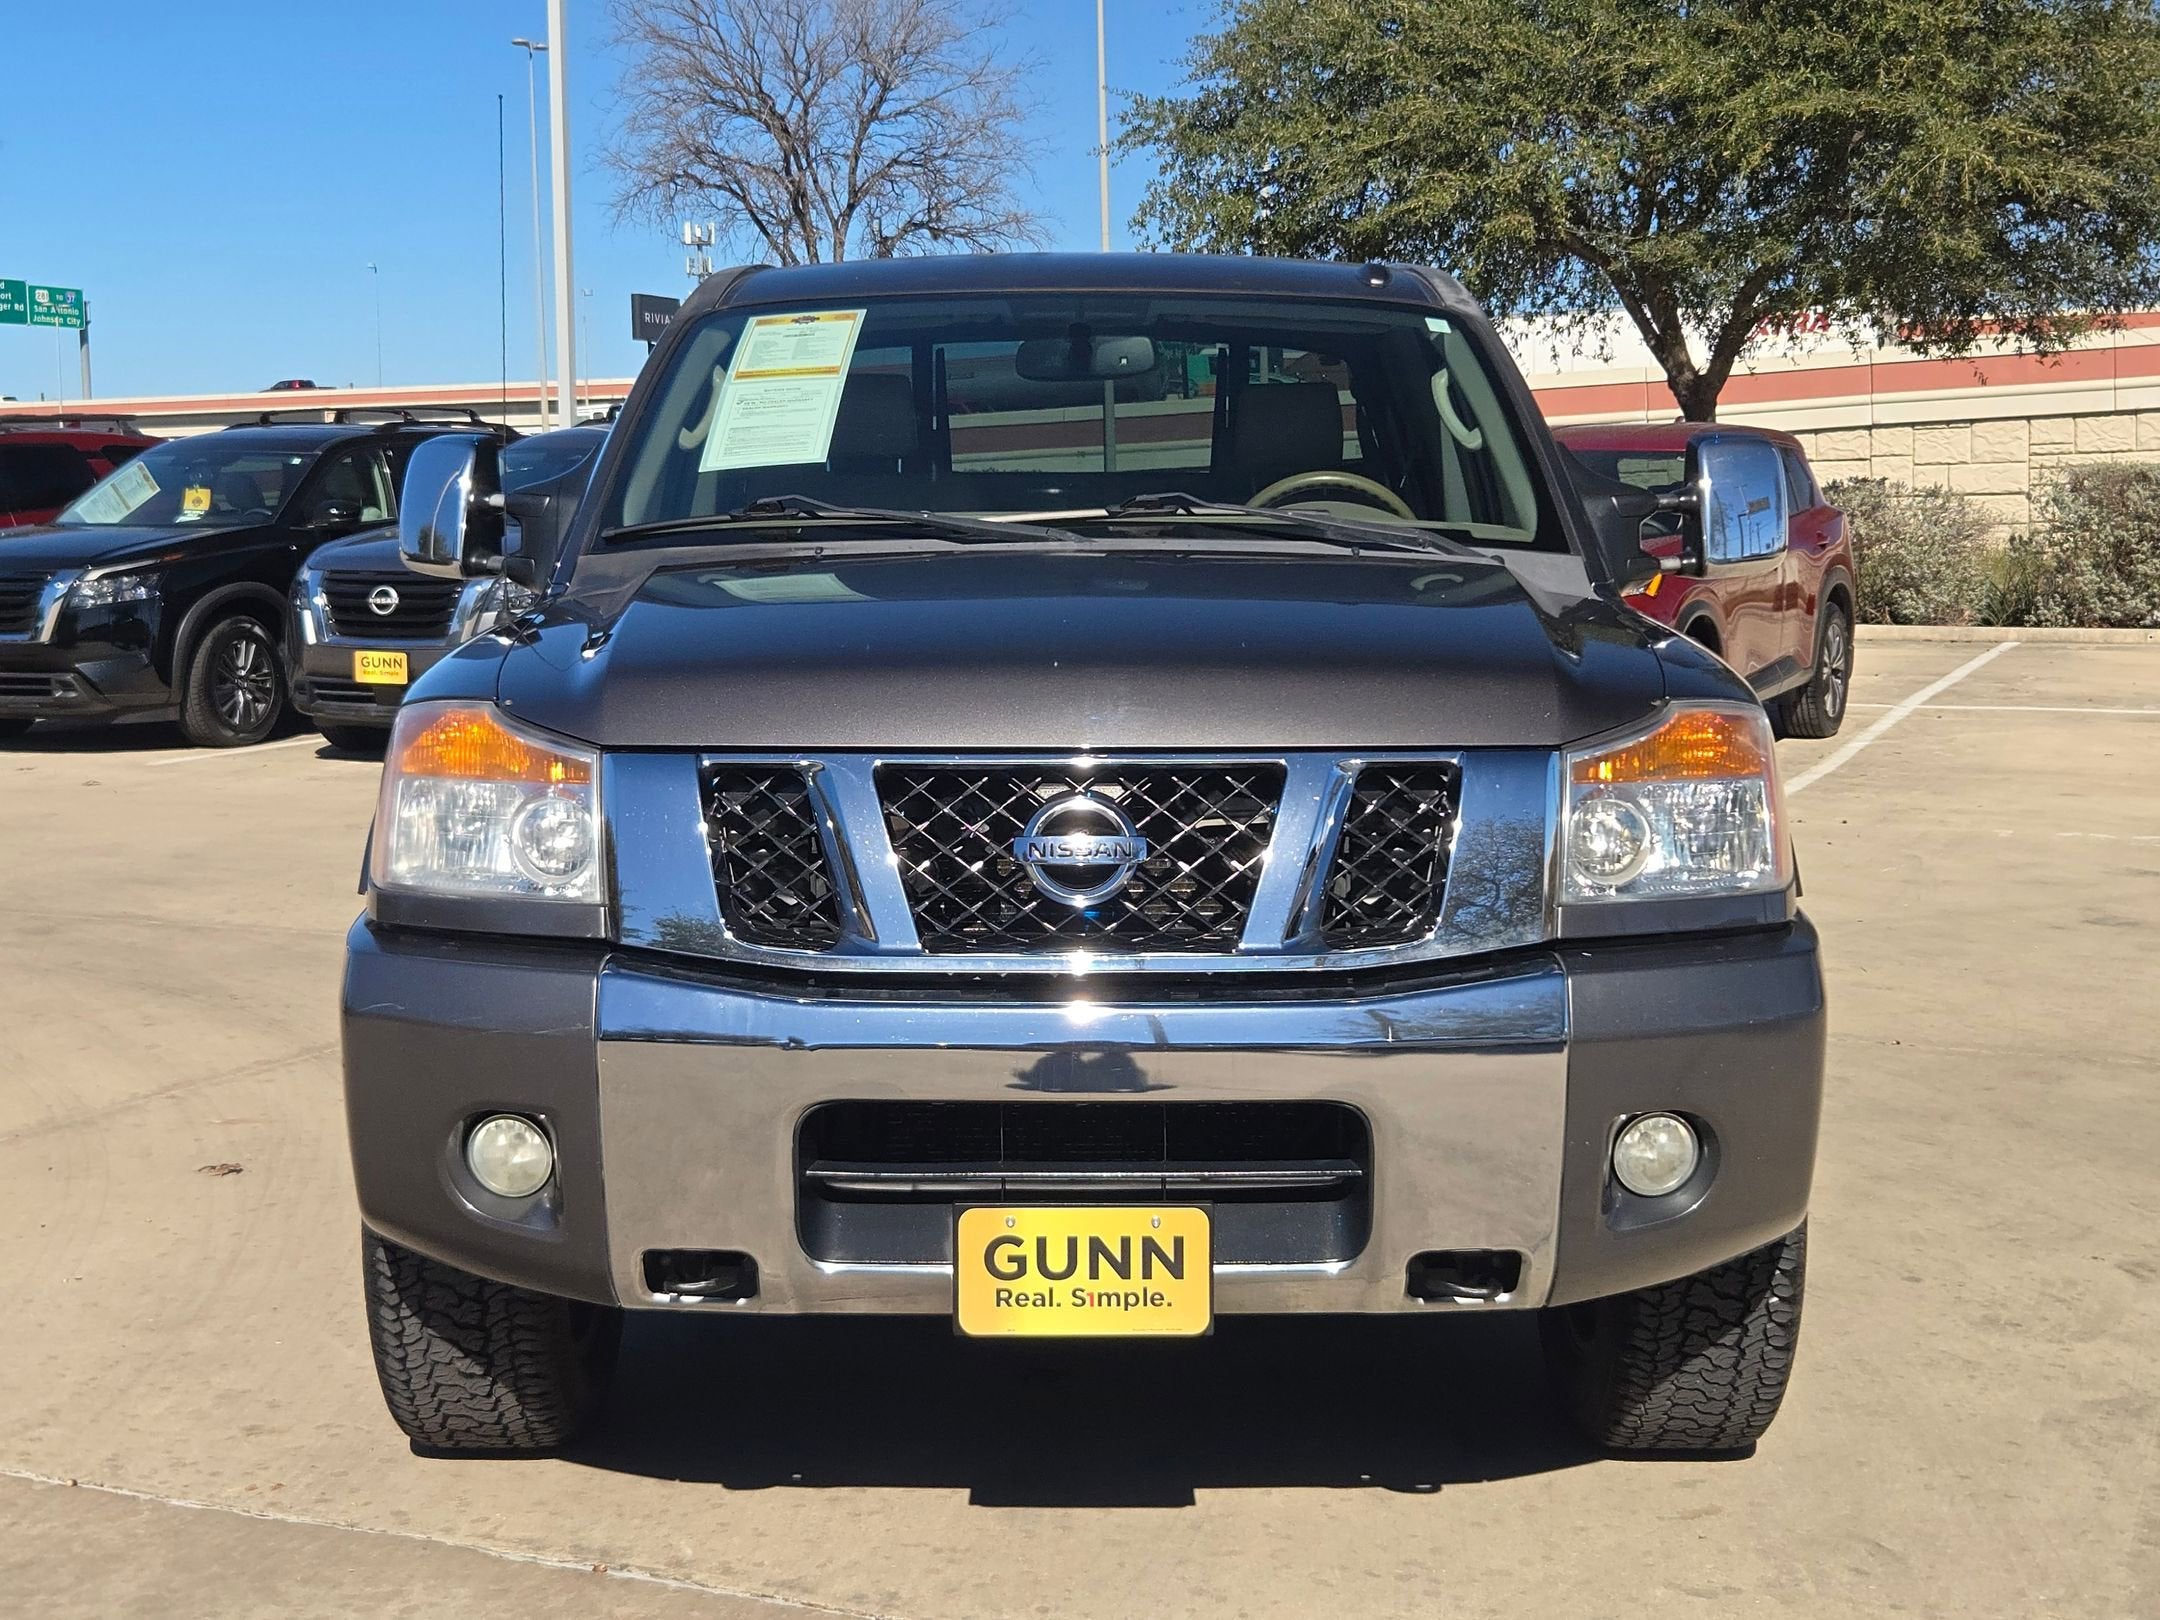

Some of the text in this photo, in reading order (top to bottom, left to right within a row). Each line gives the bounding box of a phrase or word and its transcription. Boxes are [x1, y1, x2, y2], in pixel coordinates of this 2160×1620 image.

[14, 303, 24, 312] Rd
[33, 304, 48, 313] San
[66, 317, 81, 327] City
[360, 656, 403, 669] GUNN
[1028, 842, 1133, 858] NISSAN
[983, 1234, 1185, 1281] GUNN
[995, 1287, 1062, 1308] Real.
